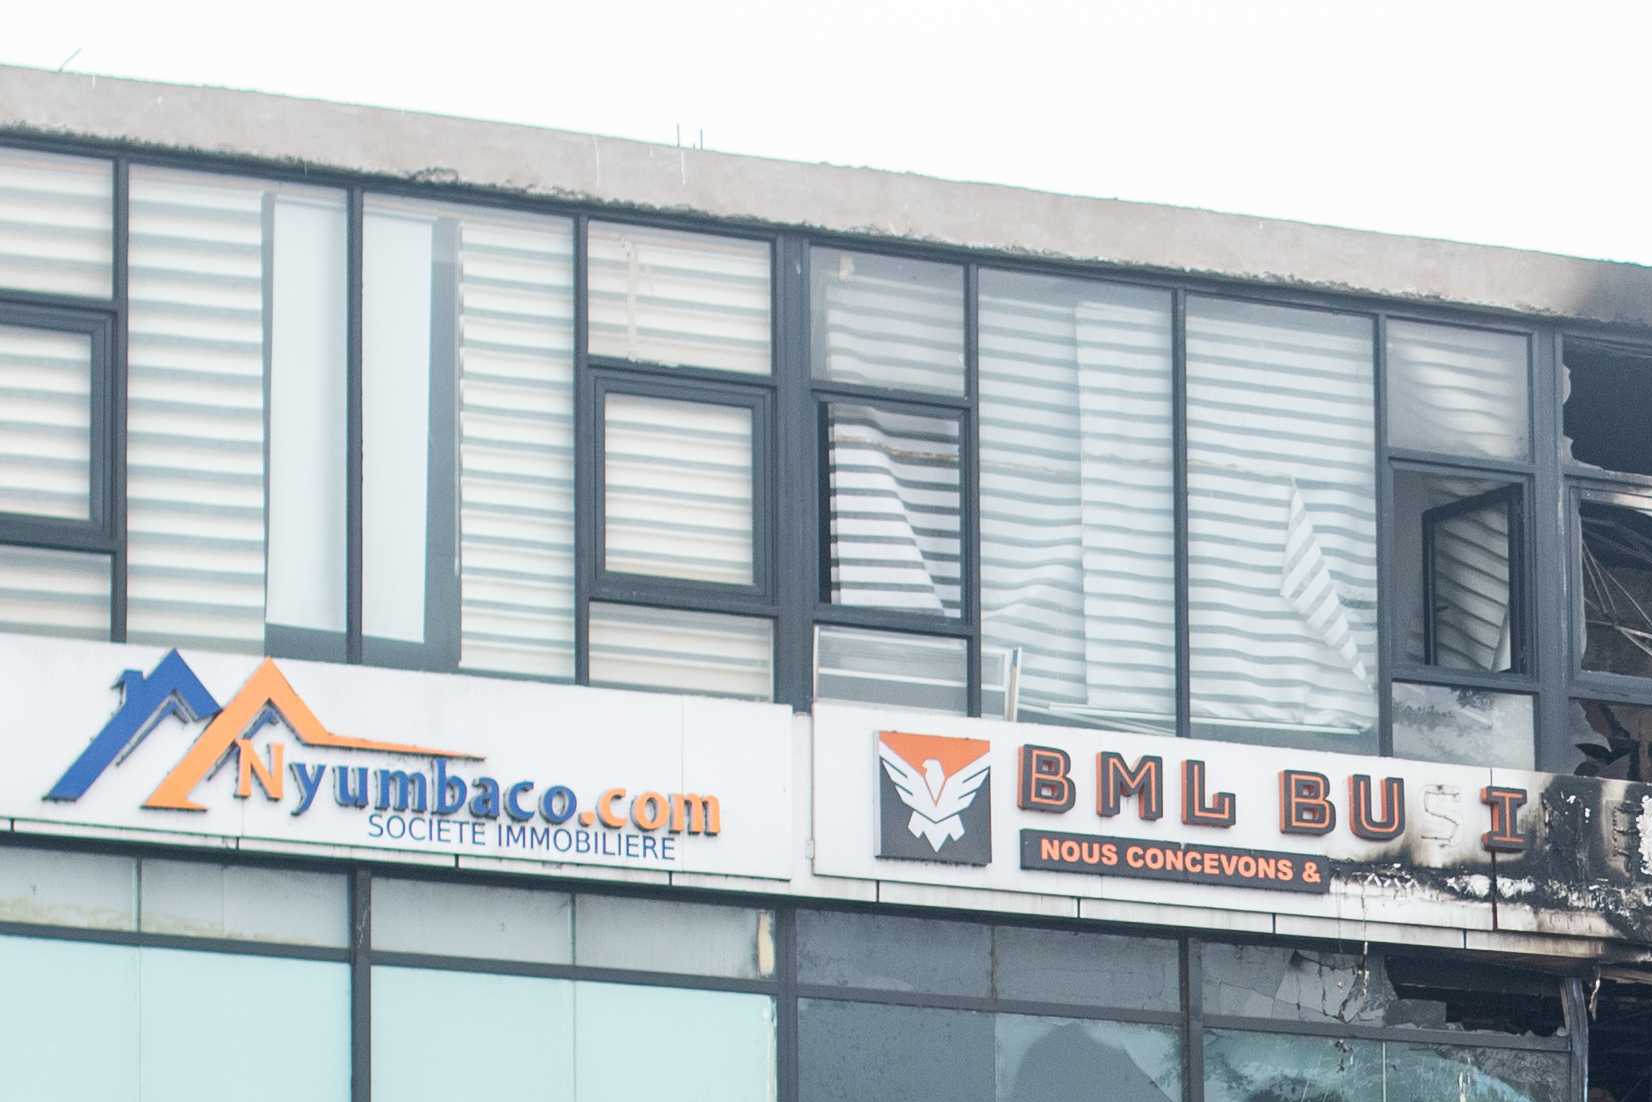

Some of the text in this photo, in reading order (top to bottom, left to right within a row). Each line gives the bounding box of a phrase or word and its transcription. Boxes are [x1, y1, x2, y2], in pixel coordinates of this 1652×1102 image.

[233, 737, 722, 837] Nyumbaco.com
[1017, 743, 1236, 828] BML
[367, 814, 676, 861] SOCIETE IMMOBILIERE
[1040, 838, 1321, 883] NOUS CONCEVONS &
